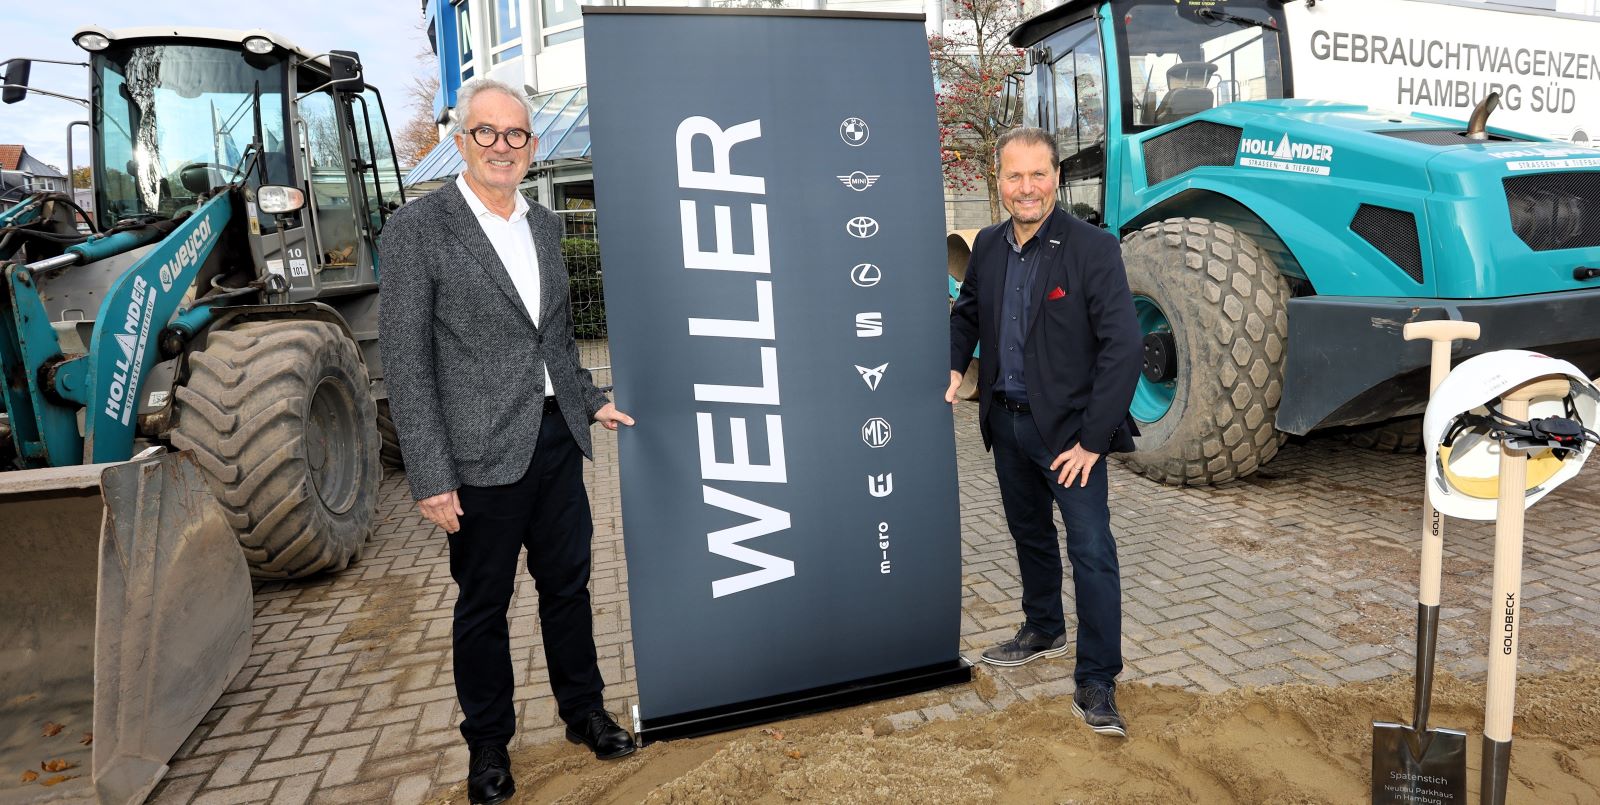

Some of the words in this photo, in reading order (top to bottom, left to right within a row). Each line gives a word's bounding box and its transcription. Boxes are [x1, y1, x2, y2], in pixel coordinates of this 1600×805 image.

[1310, 30, 1600, 80] GEBRAUCHTWAGENZEN
[1397, 77, 1522, 111] HAMBURG
[1530, 82, 1576, 114] SÜD
[1241, 132, 1333, 161] HOLLANDER
[1293, 164, 1319, 173] TIEFBAU
[169, 214, 212, 280] weycor
[287, 248, 302, 258] 10
[141, 301, 154, 338] TIEFBAU
[105, 275, 147, 420] HOLLANDER
[676, 115, 795, 598] WELLER
[1432, 508, 1440, 537] GOLD
[1503, 592, 1515, 655] GOLDBECK
[1384, 784, 1414, 794] Neubau
[1415, 787, 1454, 799] Parkhaus
[1390, 770, 1448, 785] Spatenstich
[1403, 794, 1442, 805] Hamburg
